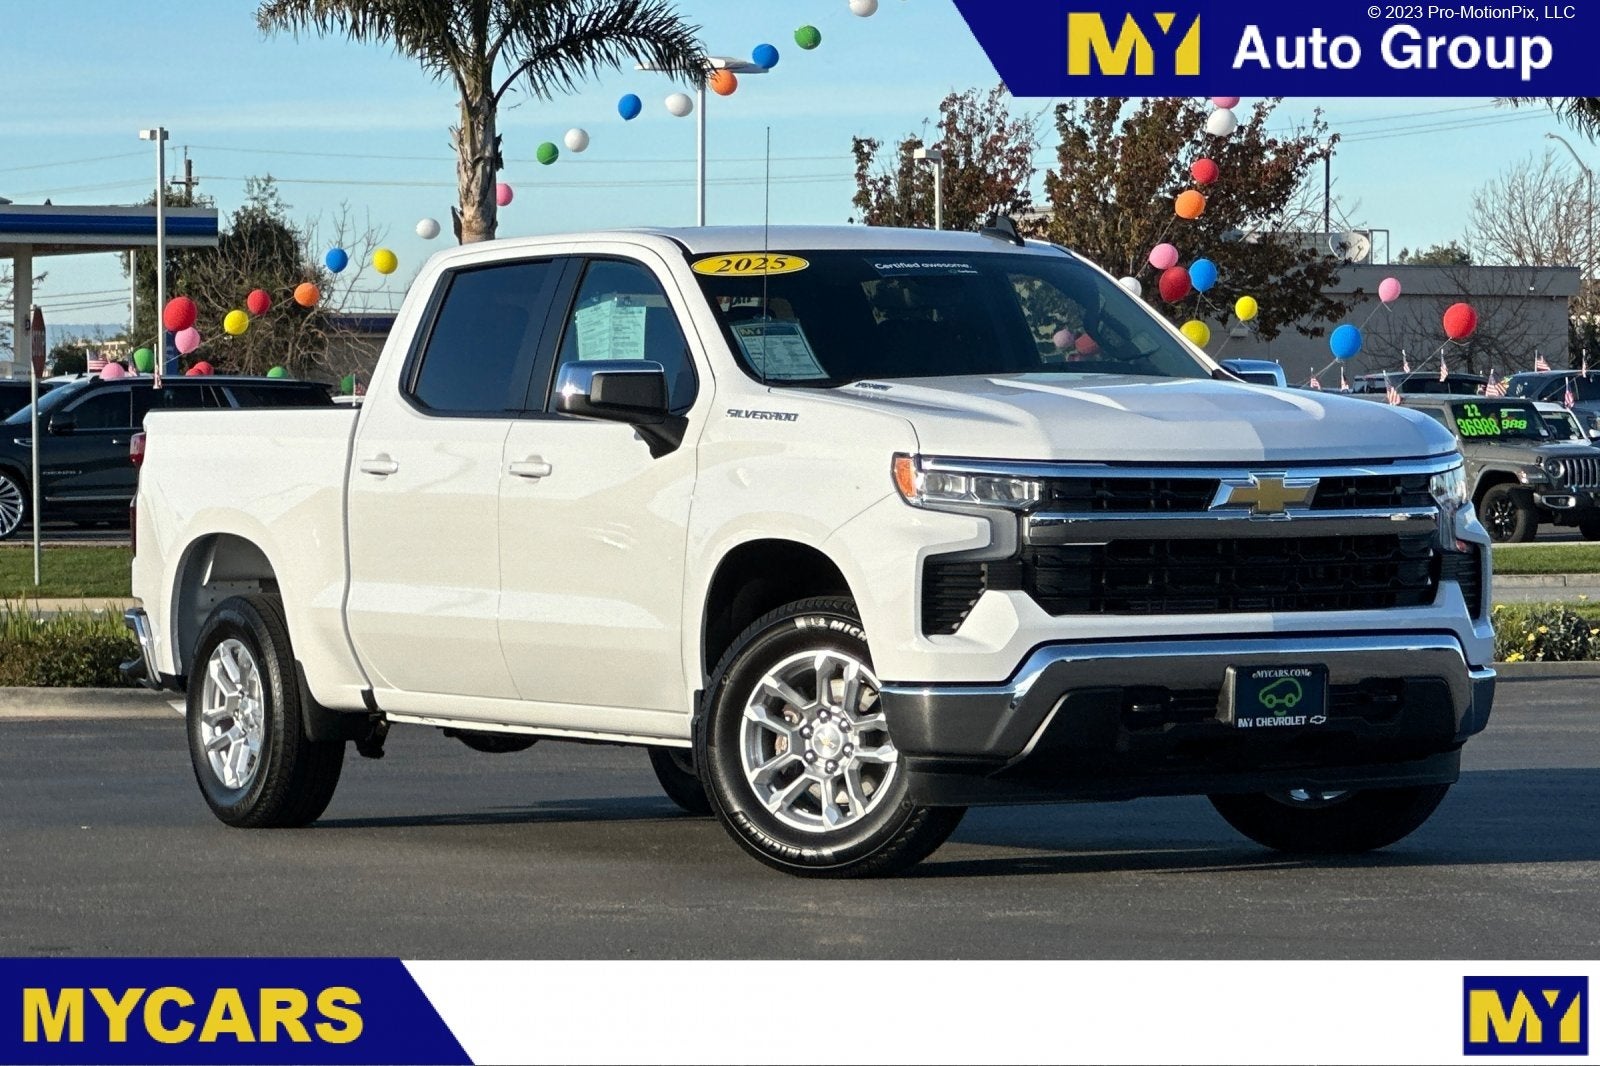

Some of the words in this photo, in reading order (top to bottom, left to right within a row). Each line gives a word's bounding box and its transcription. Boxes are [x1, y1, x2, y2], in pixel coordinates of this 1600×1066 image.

[715, 257, 789, 273] 2025
[874, 262, 921, 270] Certified
[725, 408, 799, 422] SILVERADO
[1463, 403, 1481, 417] 22
[1456, 417, 1501, 436] 36988
[1256, 715, 1307, 727] CHEVROLET
